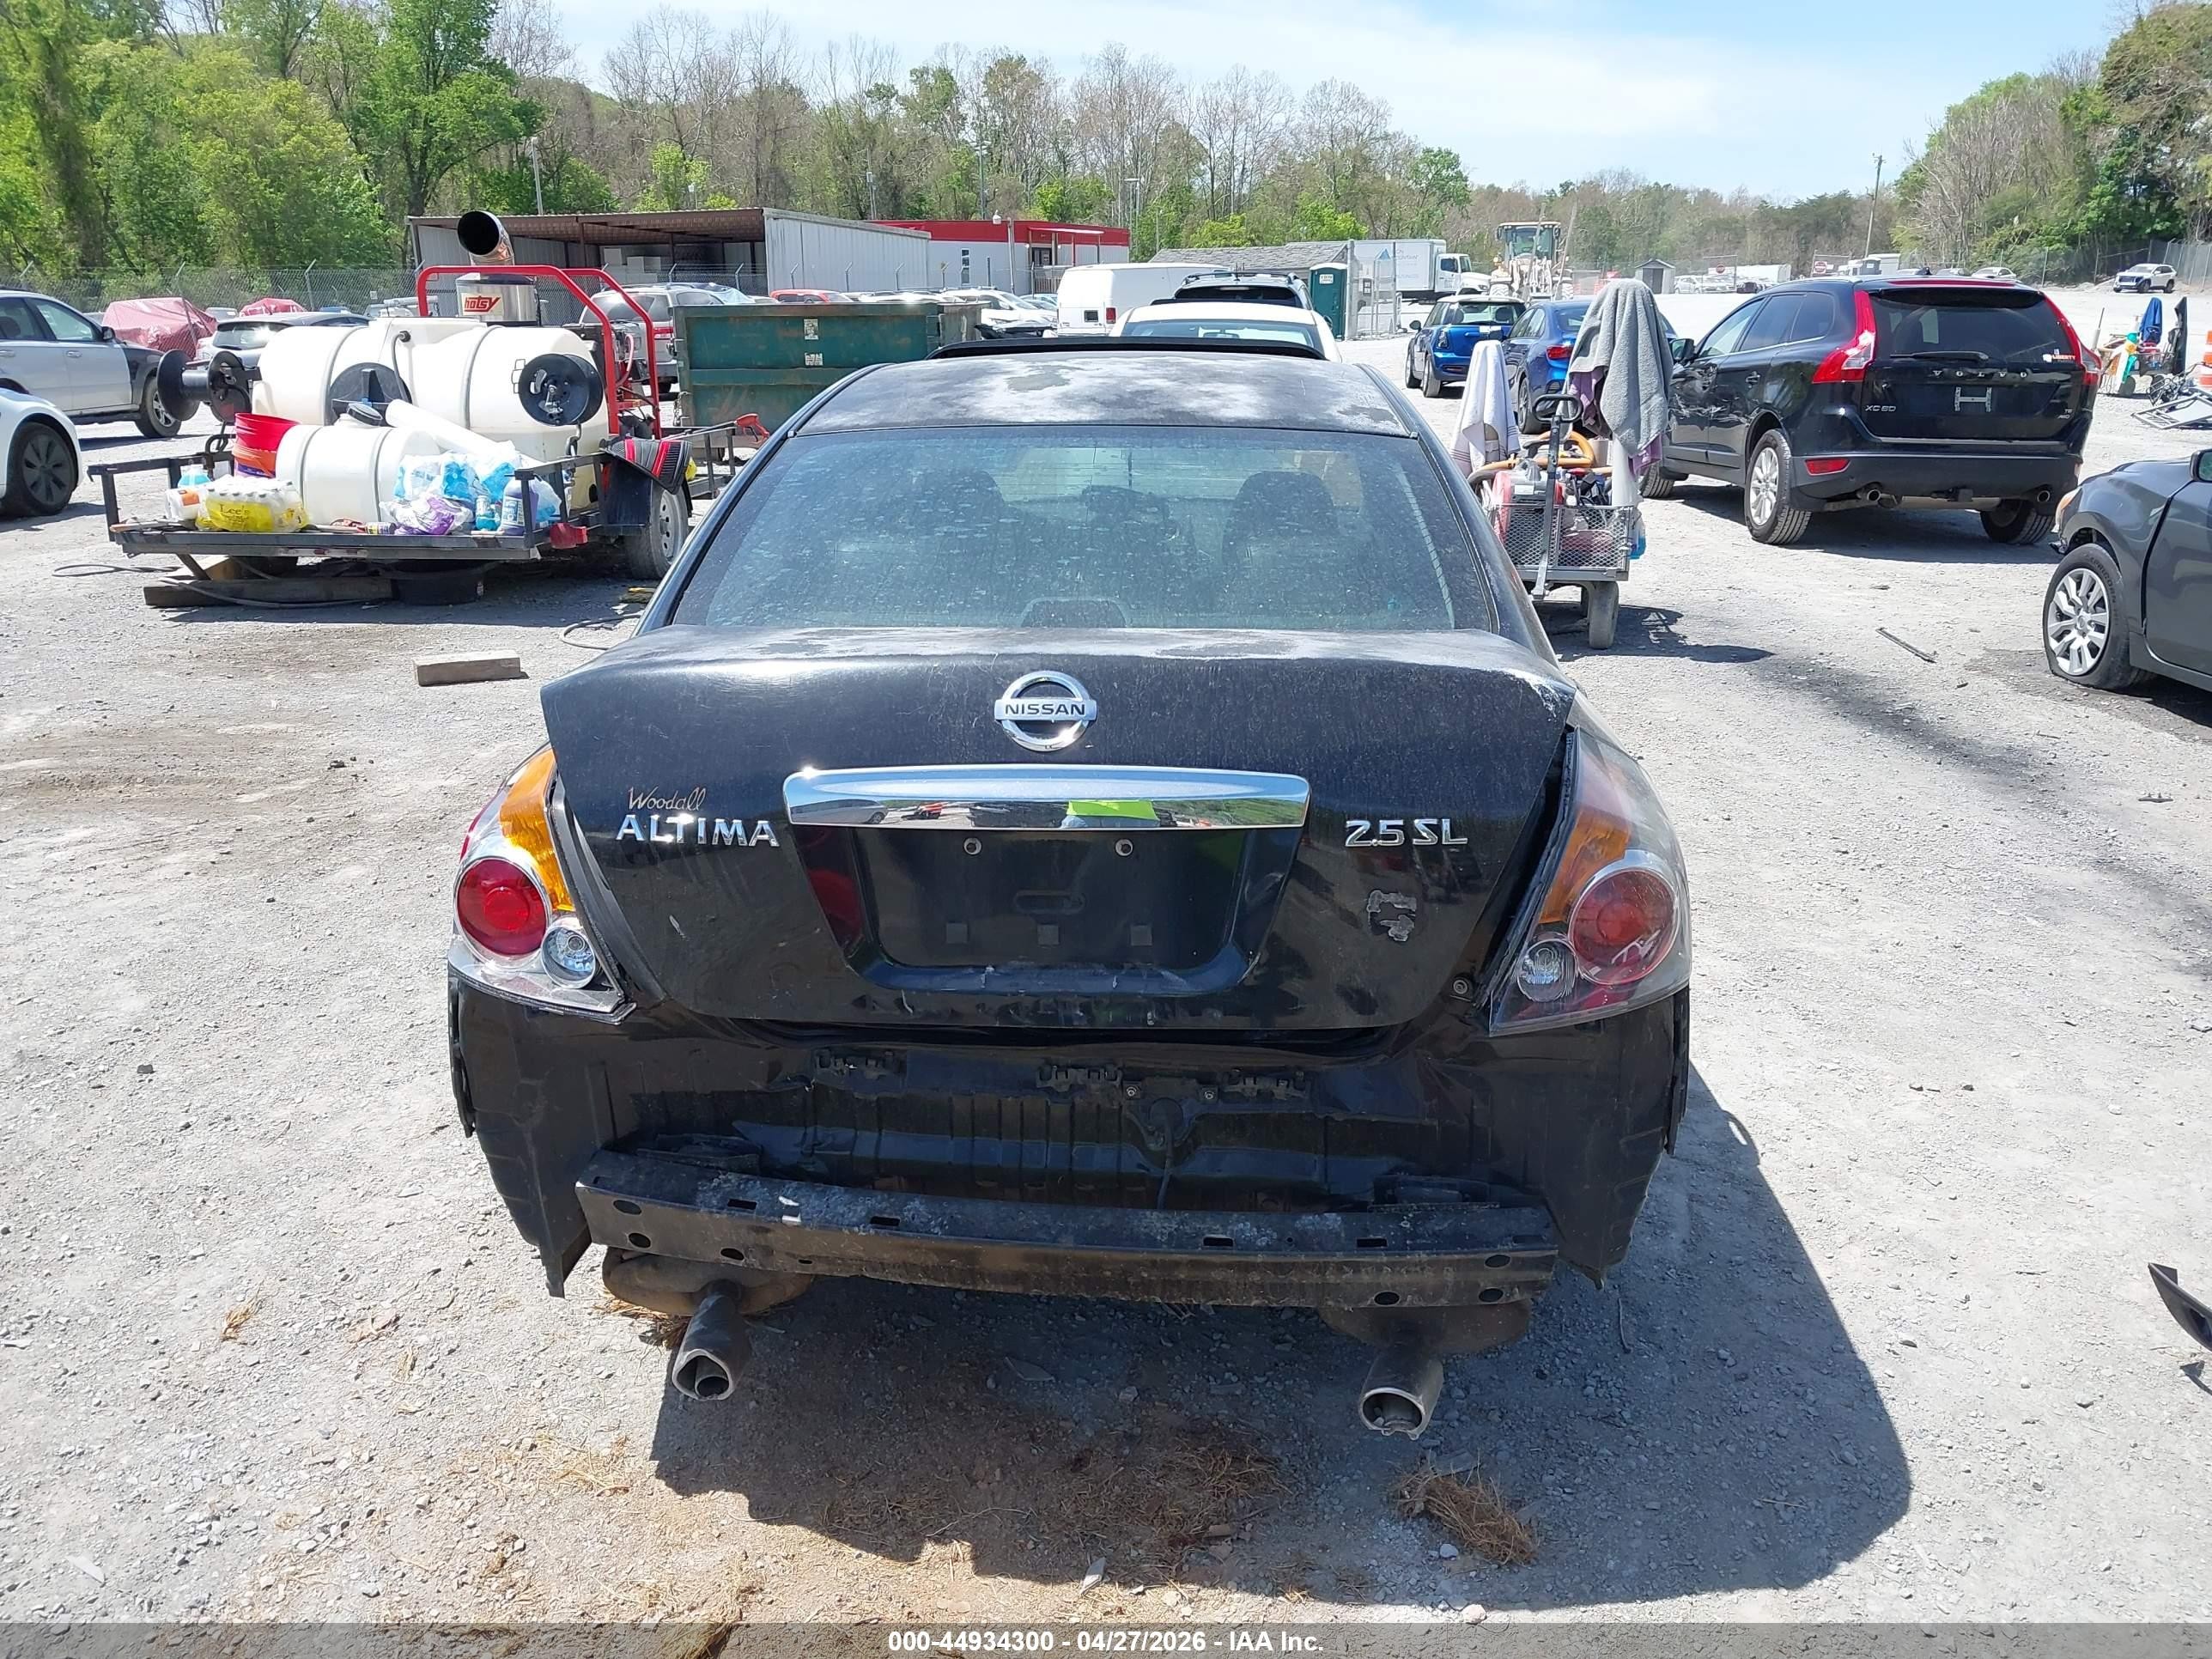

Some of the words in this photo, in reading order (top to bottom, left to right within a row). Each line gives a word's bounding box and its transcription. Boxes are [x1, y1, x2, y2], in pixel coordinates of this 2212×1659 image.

[1005, 703, 1085, 715] NISSAN
[628, 787, 707, 811] Woodall
[616, 814, 780, 847] ALTIMA
[1345, 820, 1405, 847] 2.5
[1413, 818, 1468, 845] SL
